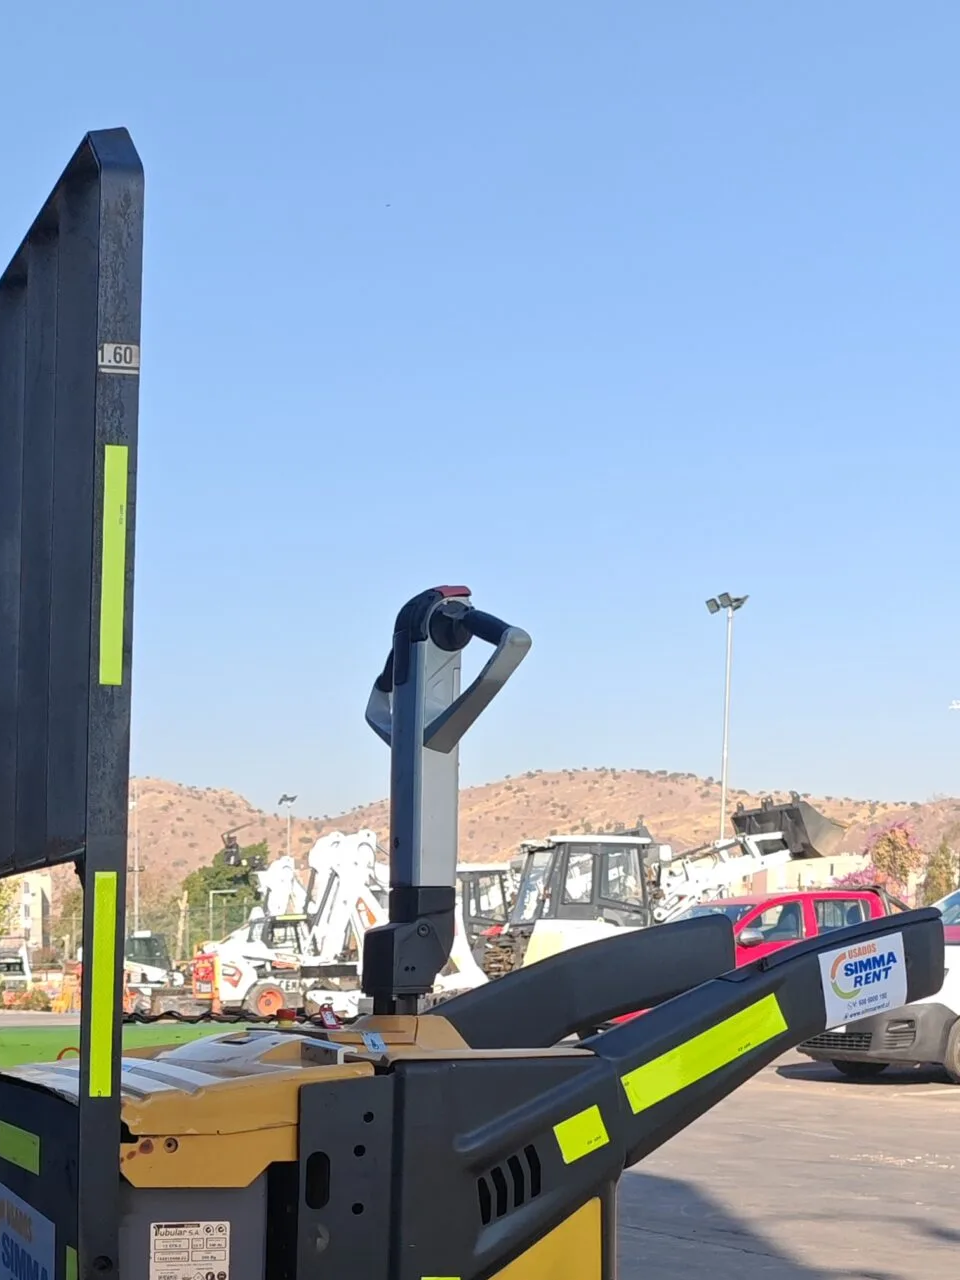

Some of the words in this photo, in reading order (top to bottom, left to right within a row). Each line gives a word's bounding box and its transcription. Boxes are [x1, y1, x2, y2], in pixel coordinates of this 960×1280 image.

[99, 345, 133, 364] 1.60
[848, 943, 877, 959] USADOS
[844, 951, 897, 977] SIMMA
[853, 966, 892, 988] RENT
